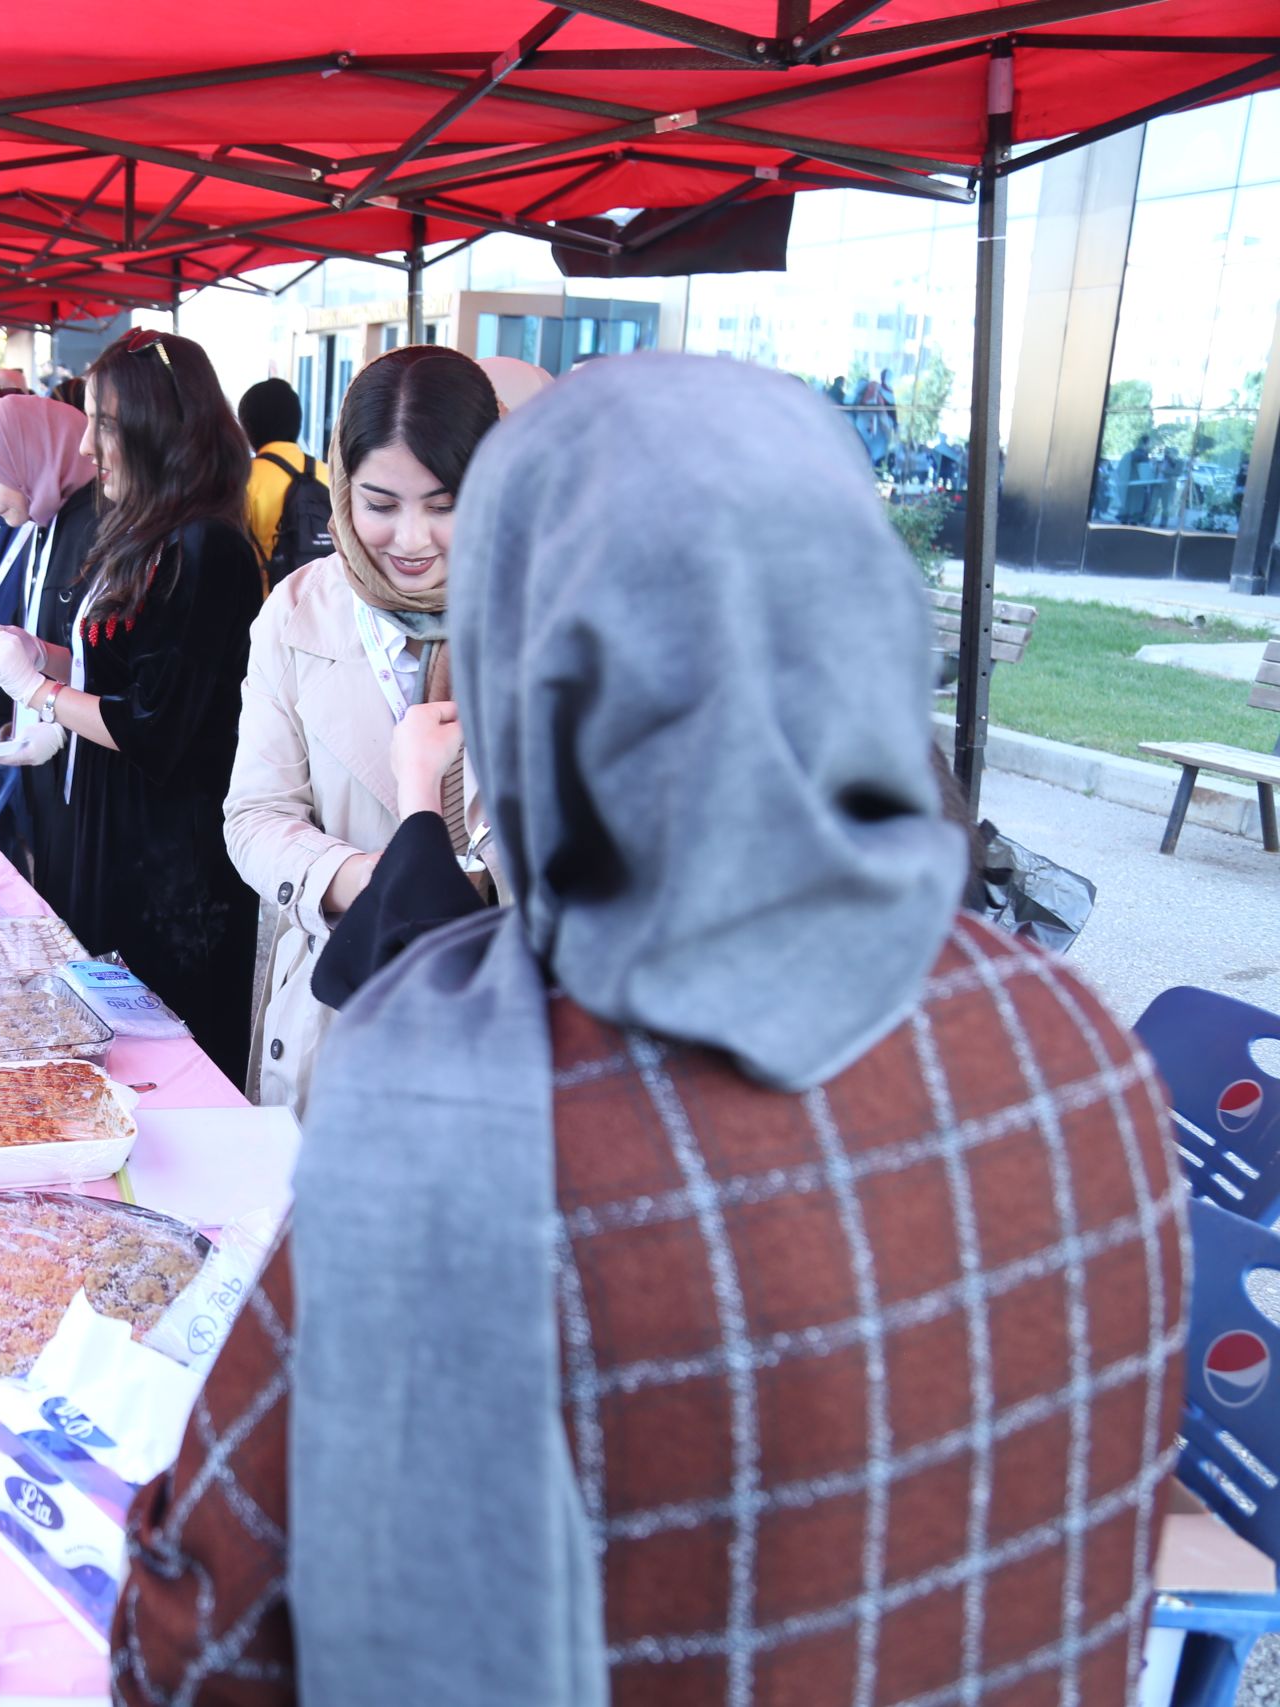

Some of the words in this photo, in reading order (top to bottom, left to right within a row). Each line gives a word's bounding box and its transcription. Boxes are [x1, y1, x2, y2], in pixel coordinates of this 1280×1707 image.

[107, 999, 137, 1010] Teb
[207, 1277, 243, 1312] Teb
[18, 1483, 52, 1526] Lia
